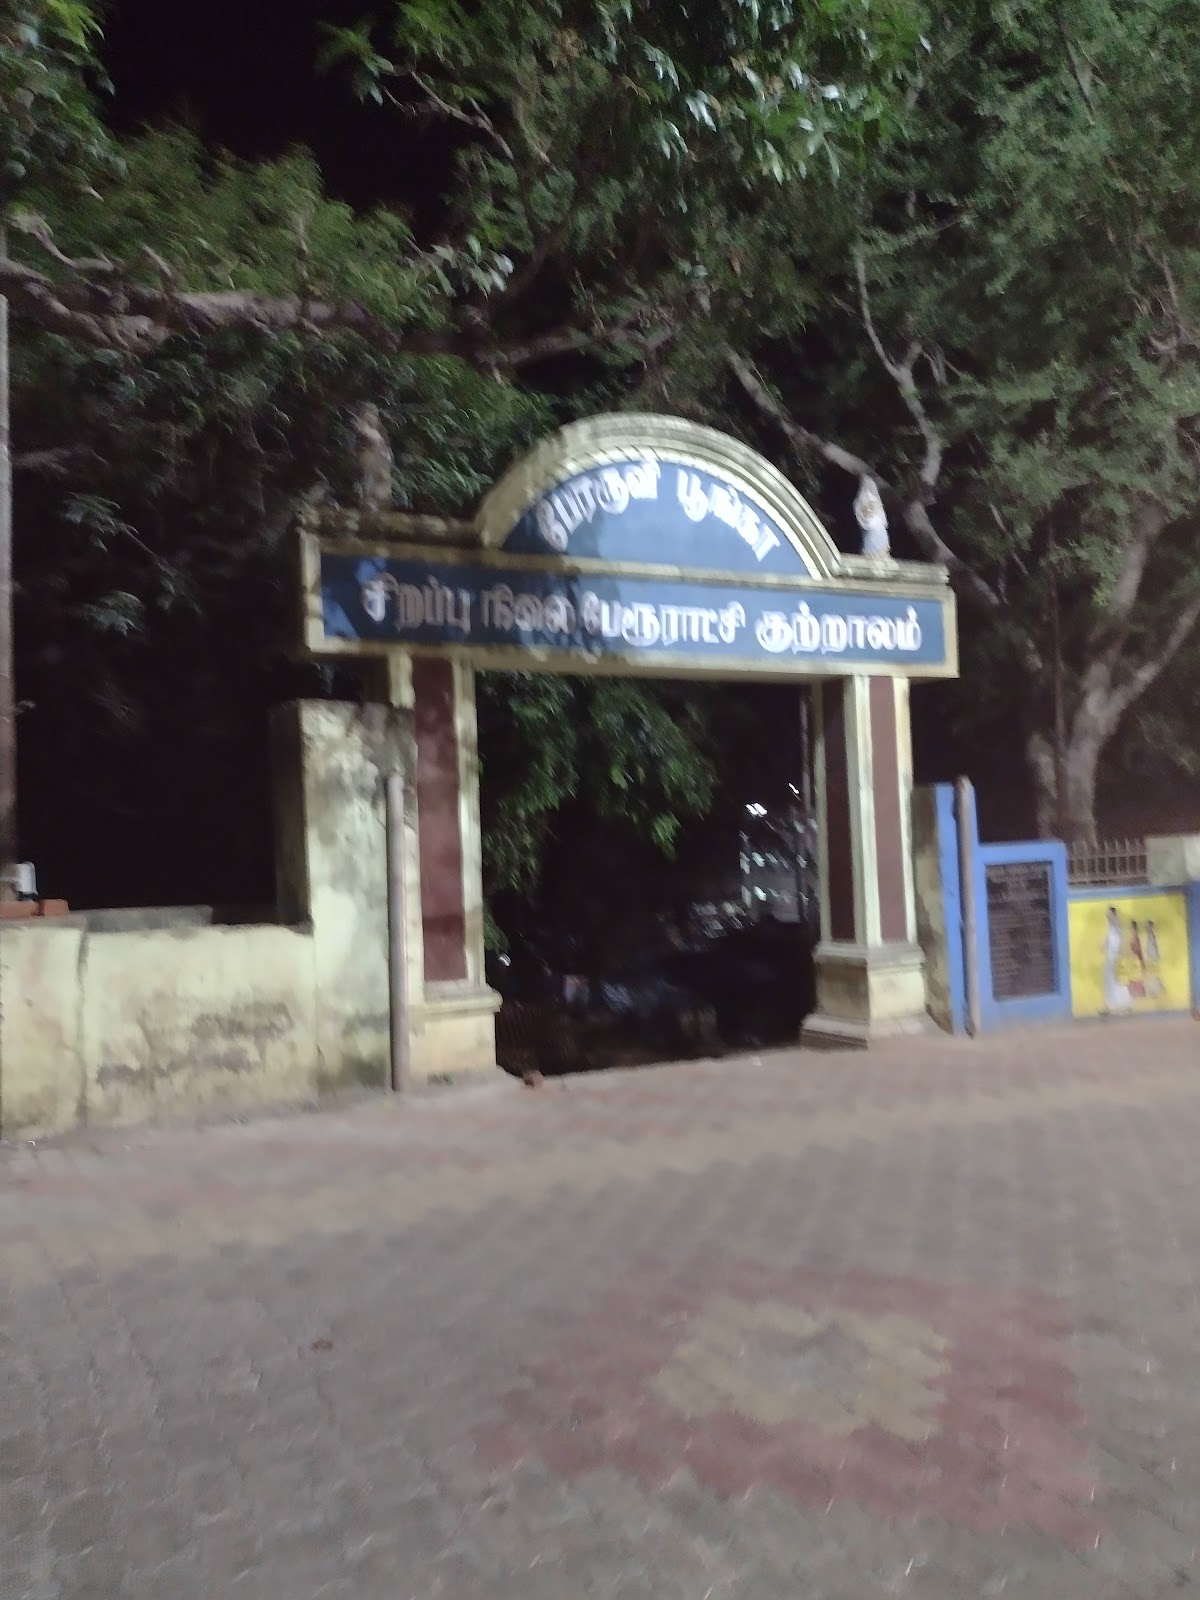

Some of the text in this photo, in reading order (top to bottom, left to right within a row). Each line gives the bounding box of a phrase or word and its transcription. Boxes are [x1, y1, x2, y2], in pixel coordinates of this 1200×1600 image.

[677, 468, 781, 561] பூங்கா
[361, 572, 922, 655] சிறப்பு நிலை பேரூராட்சி குற்றாலம்
